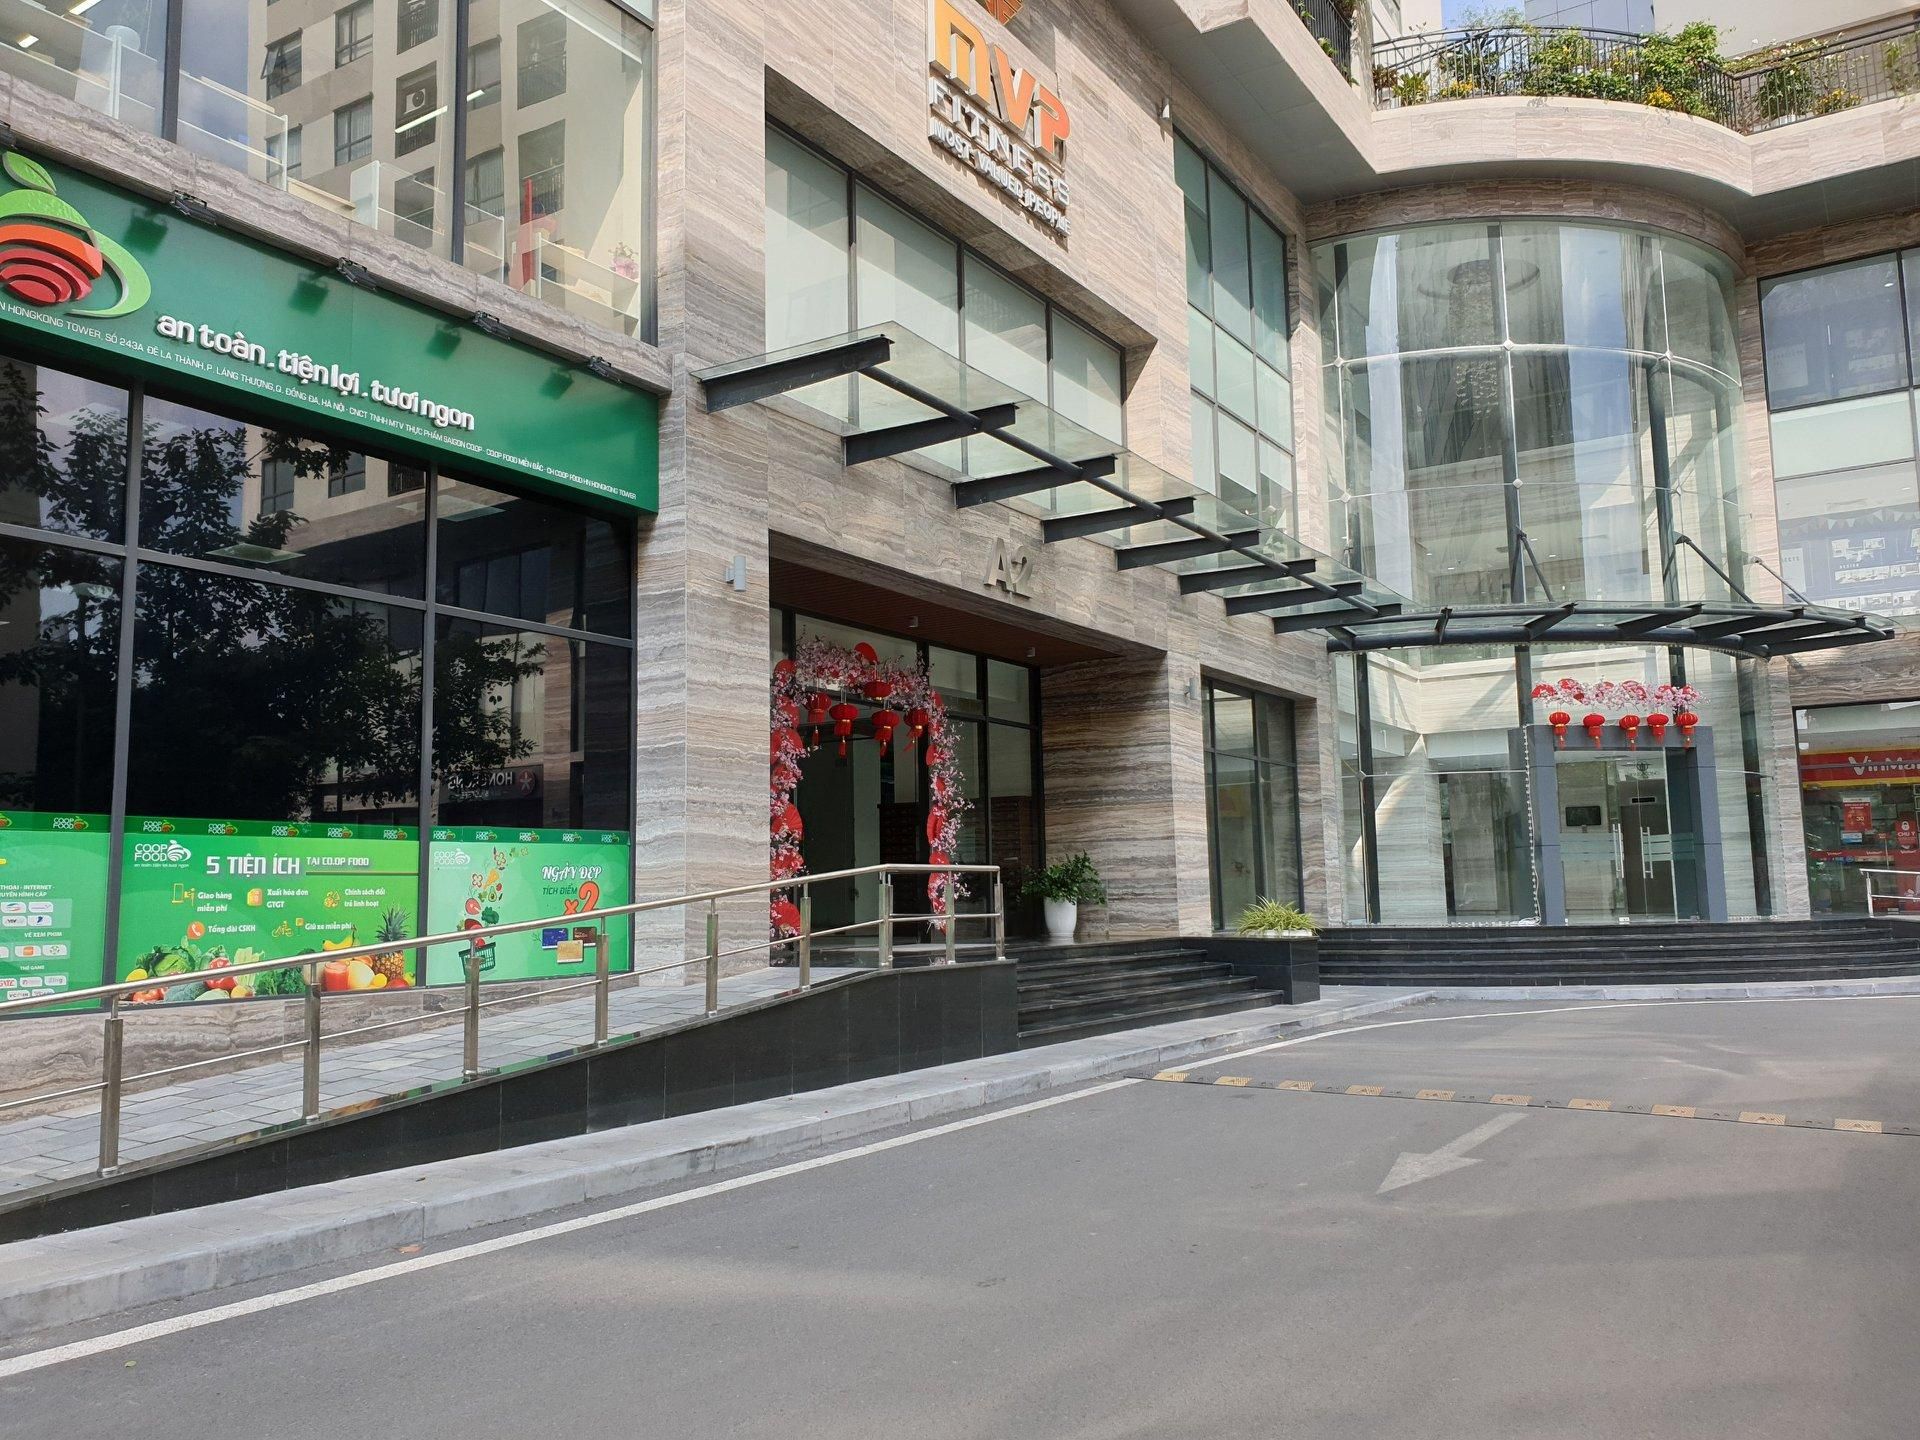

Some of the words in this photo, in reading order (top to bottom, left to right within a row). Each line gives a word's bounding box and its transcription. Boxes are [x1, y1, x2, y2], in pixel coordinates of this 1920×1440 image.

[927, 0, 1071, 155] MVP
[928, 77, 1070, 207] FITNESS
[928, 115, 972, 161] MOST
[974, 151, 1024, 205] VALUED
[1024, 189, 1071, 237] PEOPLE
[156, 315, 195, 344] an
[277, 349, 329, 385] tiện
[370, 379, 419, 413] tươi
[420, 399, 475, 431] ngon
[8, 303, 64, 328] HONGKONG
[119, 338, 144, 352] 243A
[160, 350, 172, 361] LA
[369, 413, 388, 425] TNHH
[388, 418, 405, 430] MTV
[502, 453, 518, 464] FOOD
[618, 488, 637, 500] TOWER
[984, 537, 1033, 598] A2
[134, 852, 167, 862] FOOD
[206, 856, 220, 874] 5
[226, 853, 267, 878] TIỆN
[273, 853, 300, 875] ÍCH
[306, 857, 320, 867] TẠI
[347, 857, 369, 866] FOOD
[215, 891, 233, 900] hàng
[267, 888, 282, 896] Xuất
[542, 884, 559, 895] TÍCH
[560, 882, 578, 895] ĐIỂM
[197, 903, 215, 912] miễn
[215, 903, 228, 913] phí
